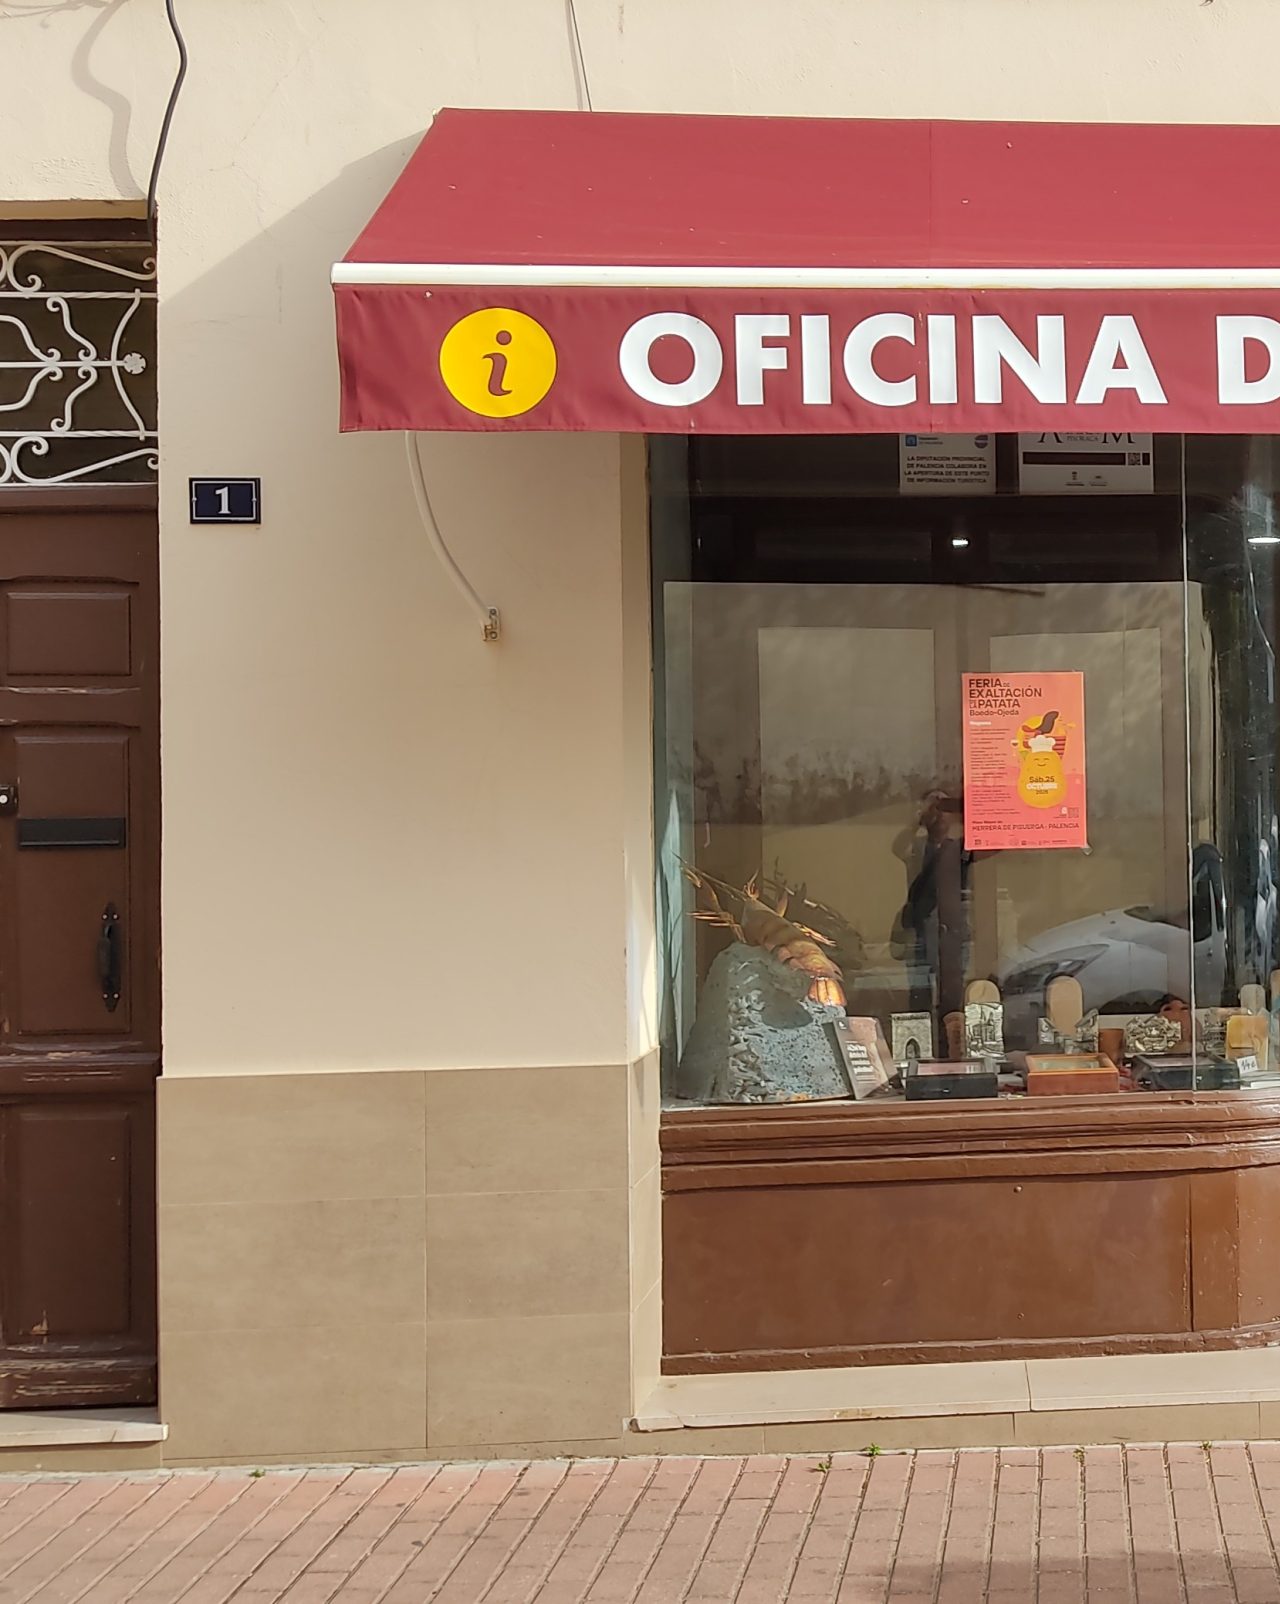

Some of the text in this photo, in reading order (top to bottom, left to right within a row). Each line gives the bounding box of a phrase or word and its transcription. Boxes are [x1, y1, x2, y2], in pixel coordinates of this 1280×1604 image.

[618, 311, 1169, 408] OFICINA
[215, 486, 232, 514] 1
[968, 678, 1002, 688] FERIA
[969, 685, 1042, 698] EXALTACIÓN
[978, 699, 1021, 709] PATATA
[969, 709, 1020, 717] Boedo-Ojeda
